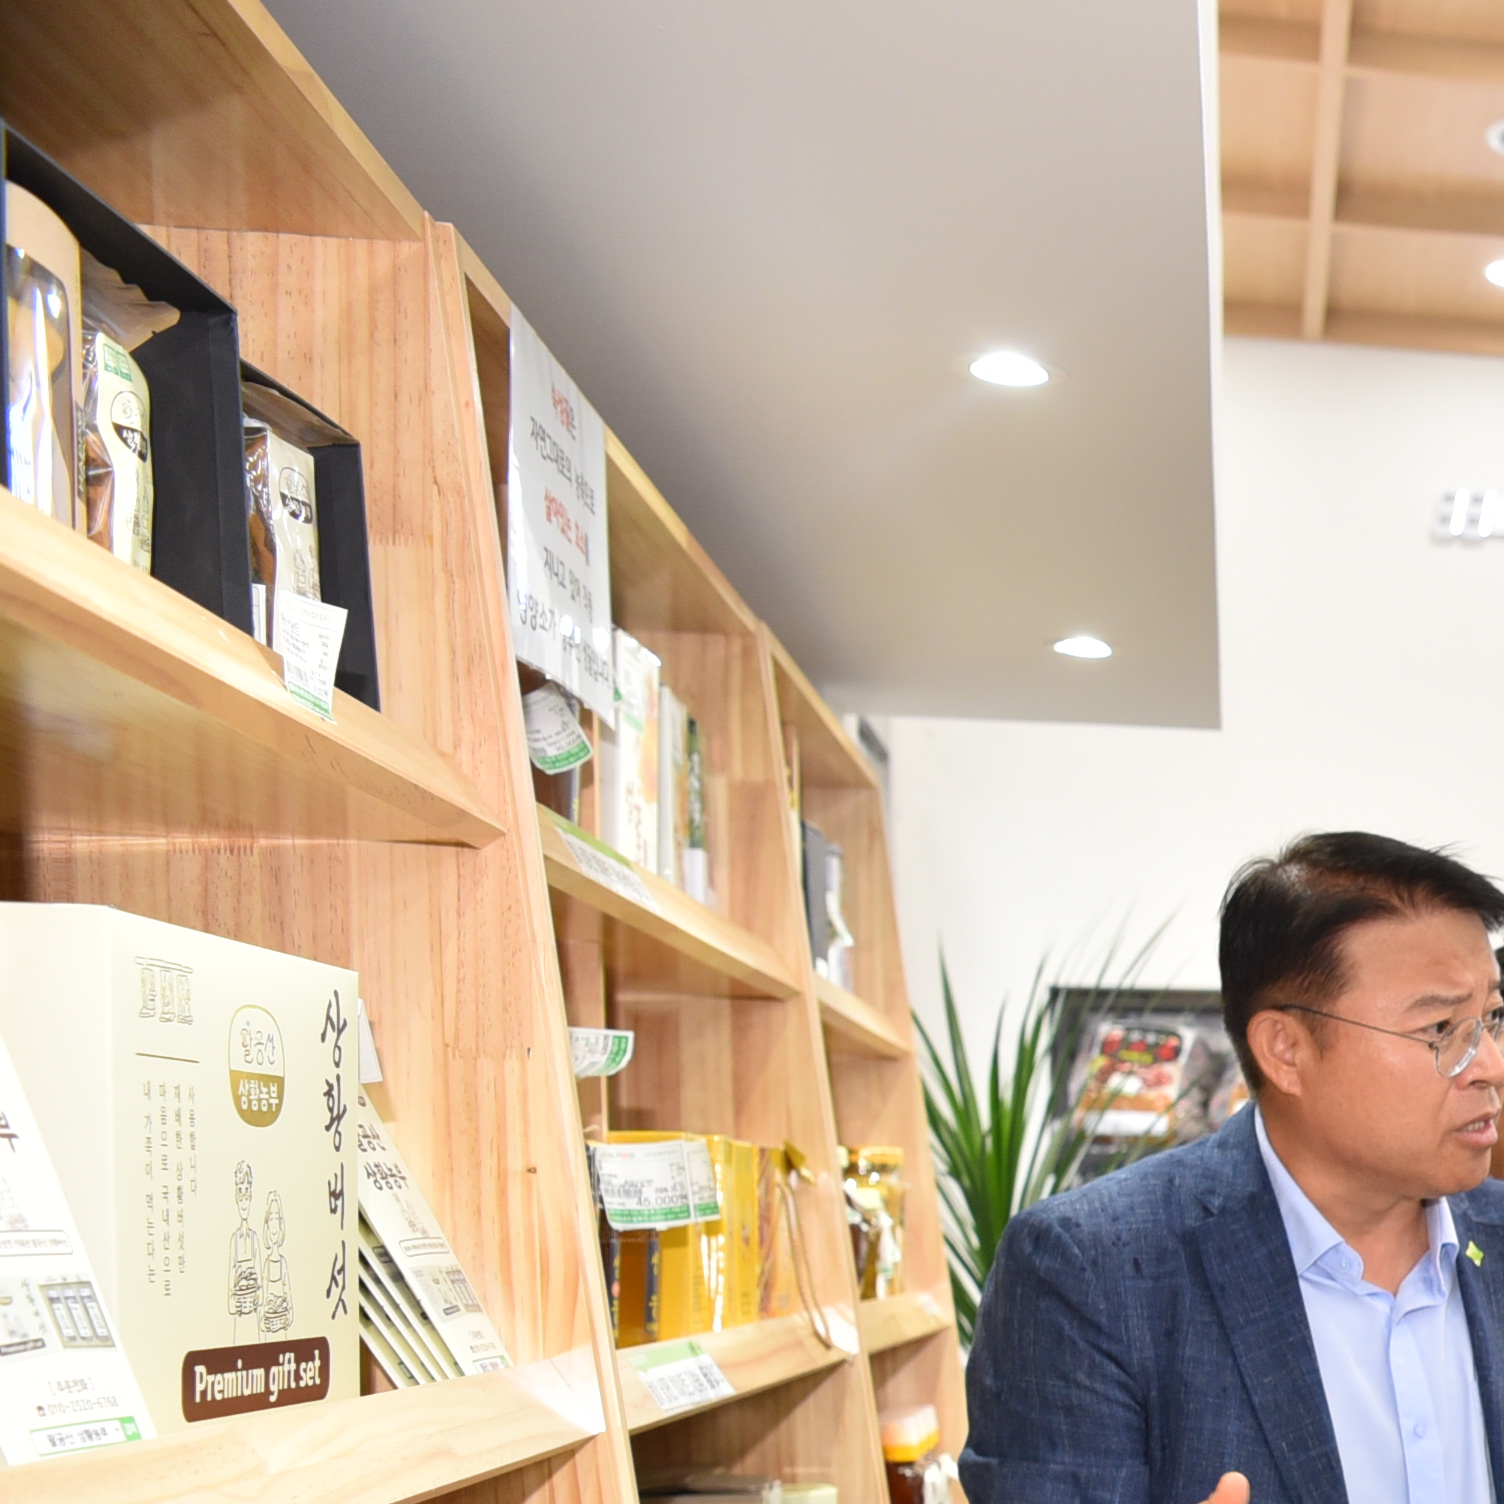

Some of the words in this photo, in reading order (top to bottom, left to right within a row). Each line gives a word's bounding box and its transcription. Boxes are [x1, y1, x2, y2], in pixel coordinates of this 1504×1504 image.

[237, 1078, 280, 1113] 상황농부
[320, 988, 349, 1322] 상황버섯
[363, 1160, 410, 1191] 상황농부
[194, 1355, 266, 1404] Premium
[269, 1352, 296, 1397] gift
[298, 1350, 322, 1388] set
